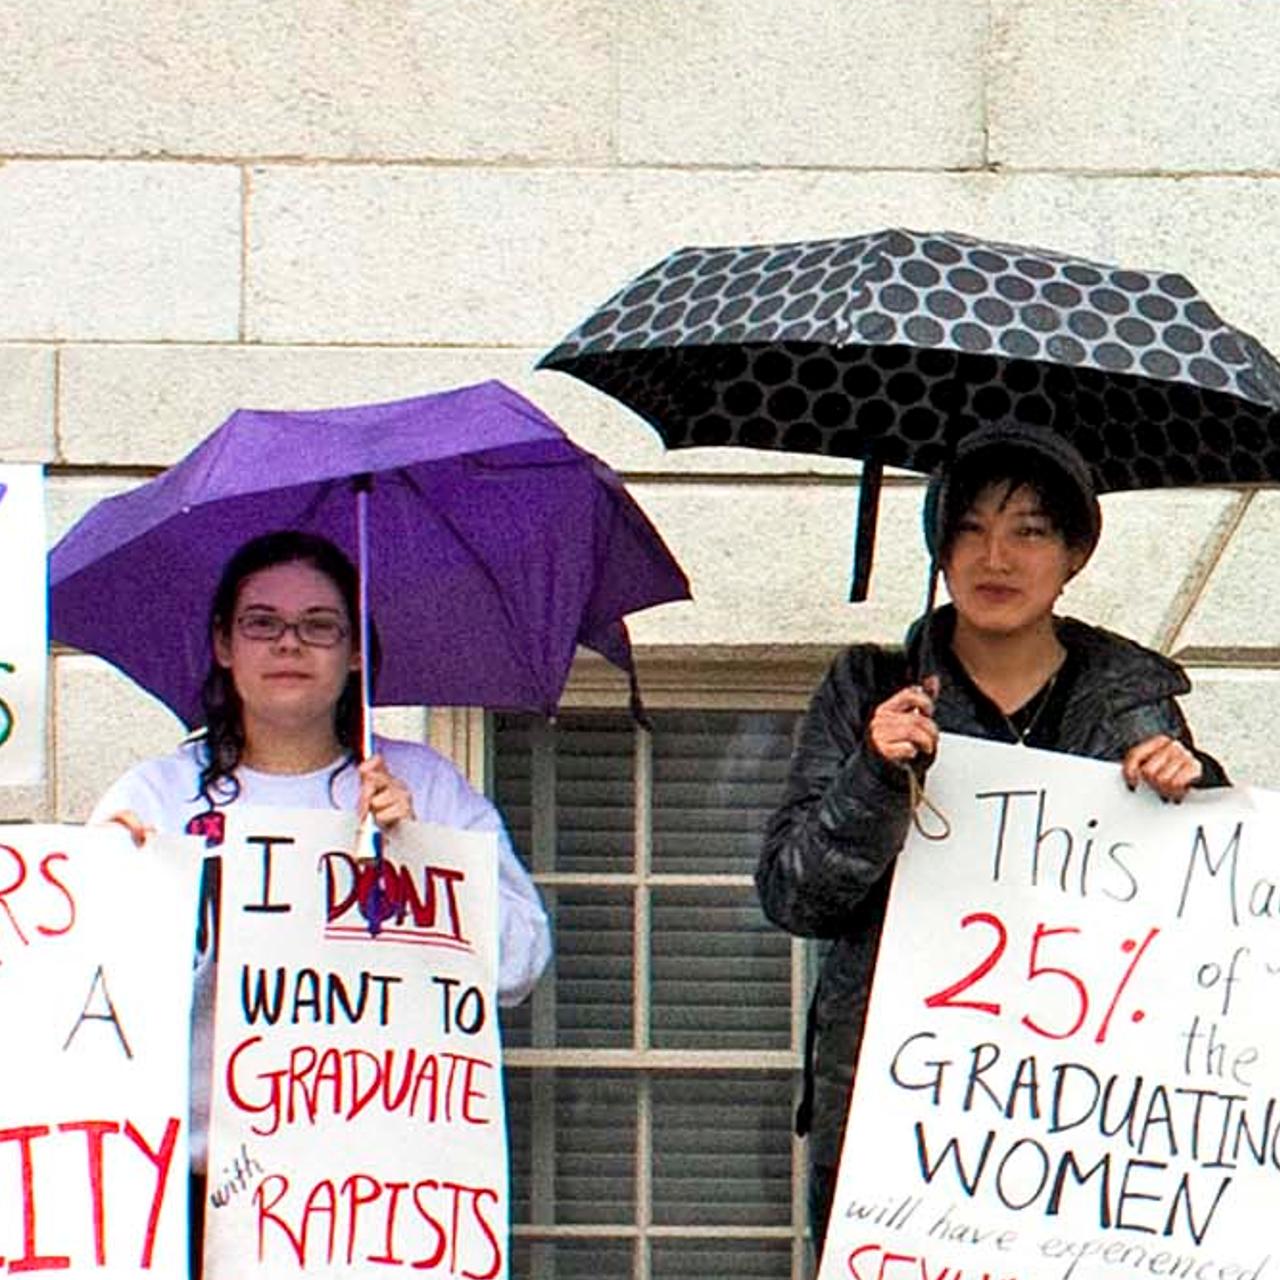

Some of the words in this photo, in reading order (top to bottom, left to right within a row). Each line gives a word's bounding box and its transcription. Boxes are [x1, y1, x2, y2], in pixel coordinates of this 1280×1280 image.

[243, 836, 296, 913] I
[975, 788, 1139, 903] This
[63, 964, 134, 1061] A
[241, 965, 403, 1026] WANT
[432, 976, 486, 1036] TO
[923, 912, 1161, 1044] 25%
[1197, 947, 1251, 1016] of
[226, 1036, 494, 1136] GRADUATE
[1180, 1015, 1260, 1086] the
[0, 1117, 181, 1275] ITY
[210, 1143, 265, 1210] with
[252, 1174, 502, 1280] RAPISTS
[844, 1196, 920, 1231] will
[927, 1204, 1018, 1252] have
[914, 1122, 1234, 1246] WOMEN
